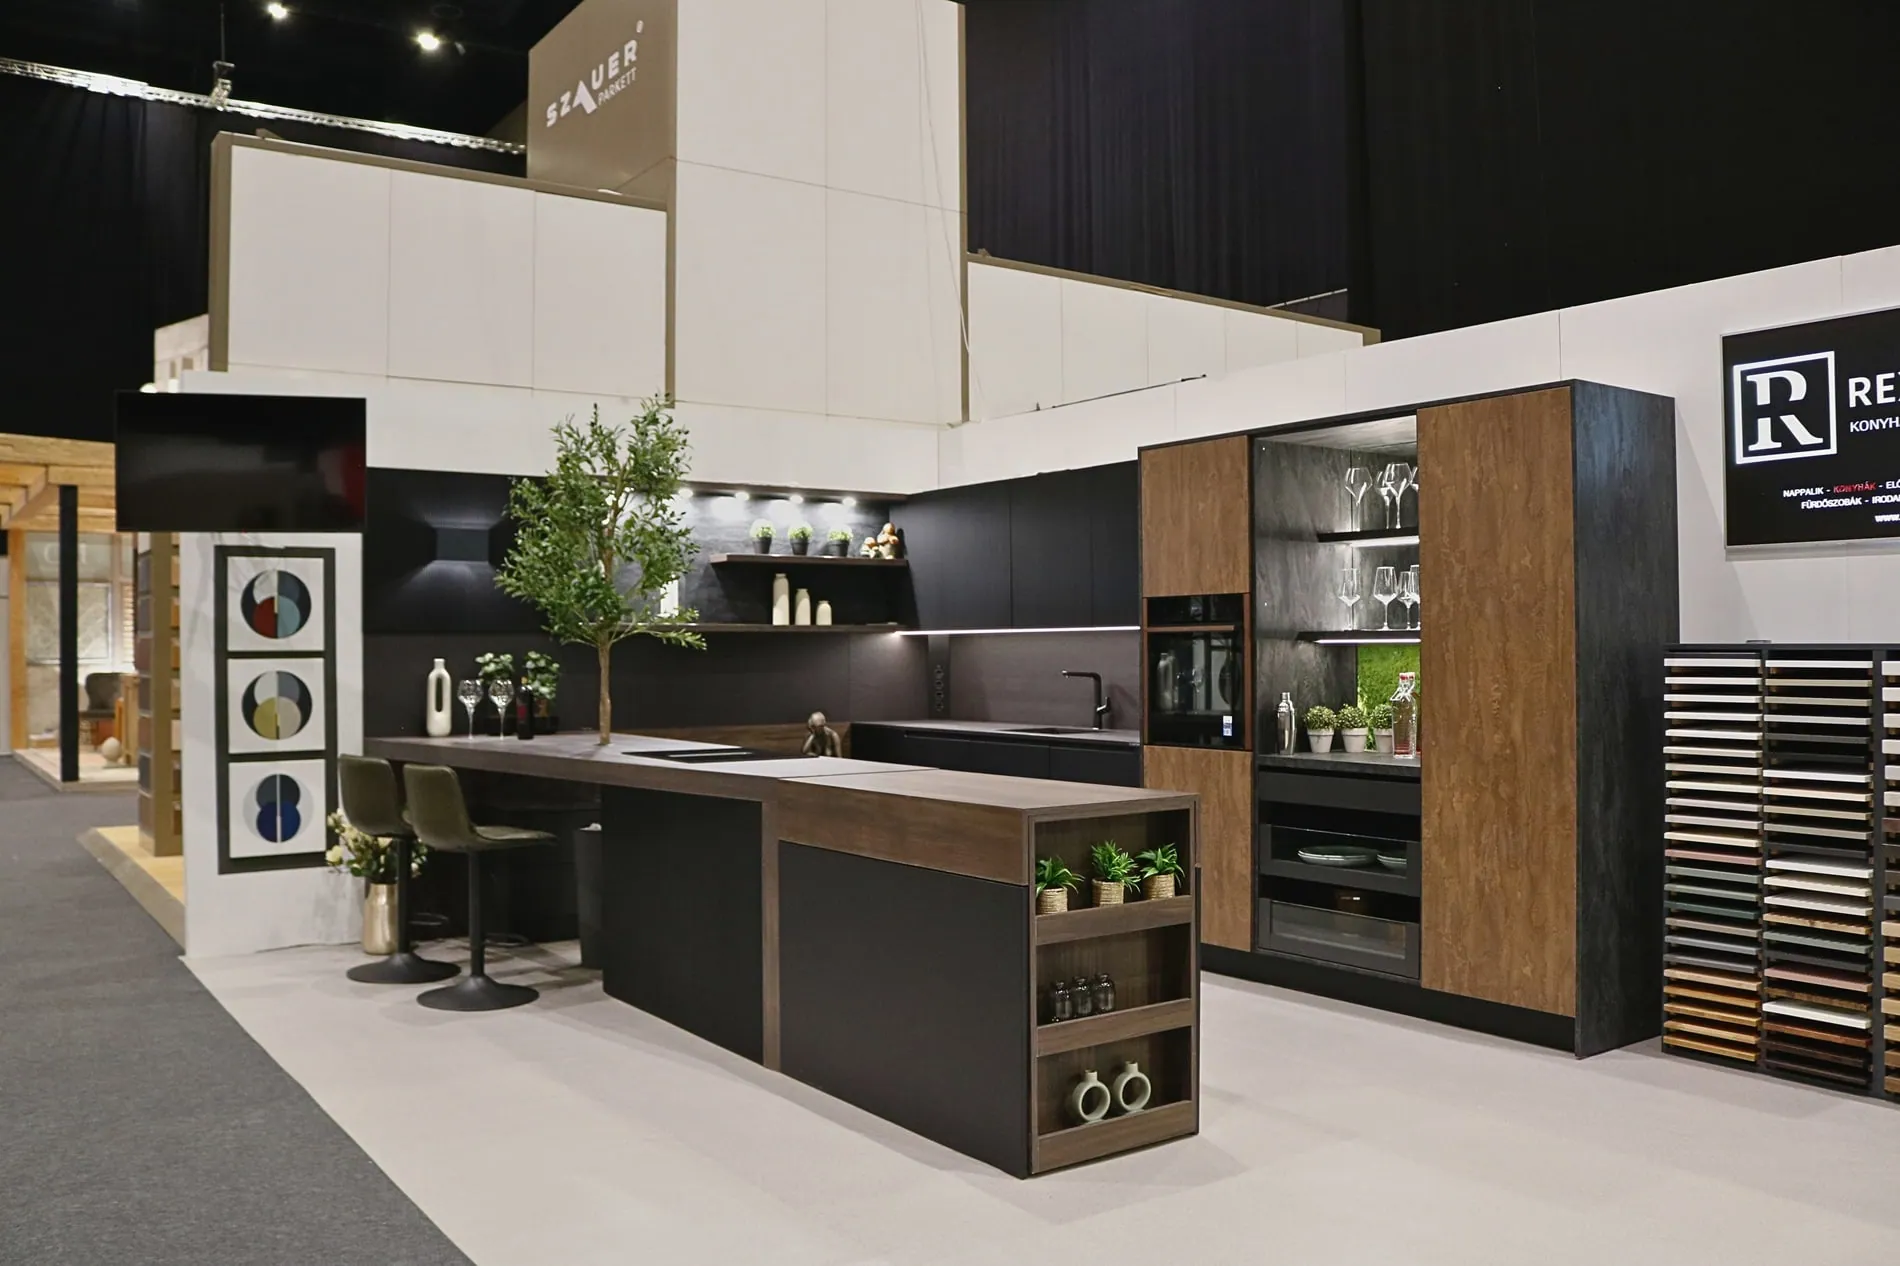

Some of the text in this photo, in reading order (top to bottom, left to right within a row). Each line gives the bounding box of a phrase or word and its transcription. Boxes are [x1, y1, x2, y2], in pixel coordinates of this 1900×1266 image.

[546, 39, 638, 128] SZAUER
[598, 66, 637, 107] PARKETT
[1848, 371, 1900, 408] RE
[1746, 370, 1824, 451] R
[1850, 416, 1900, 433] KONYH
[1783, 486, 1824, 498] NAPPALIK
[1833, 481, 1876, 494] KONYHÁK
[1871, 494, 1900, 504] IRODA
